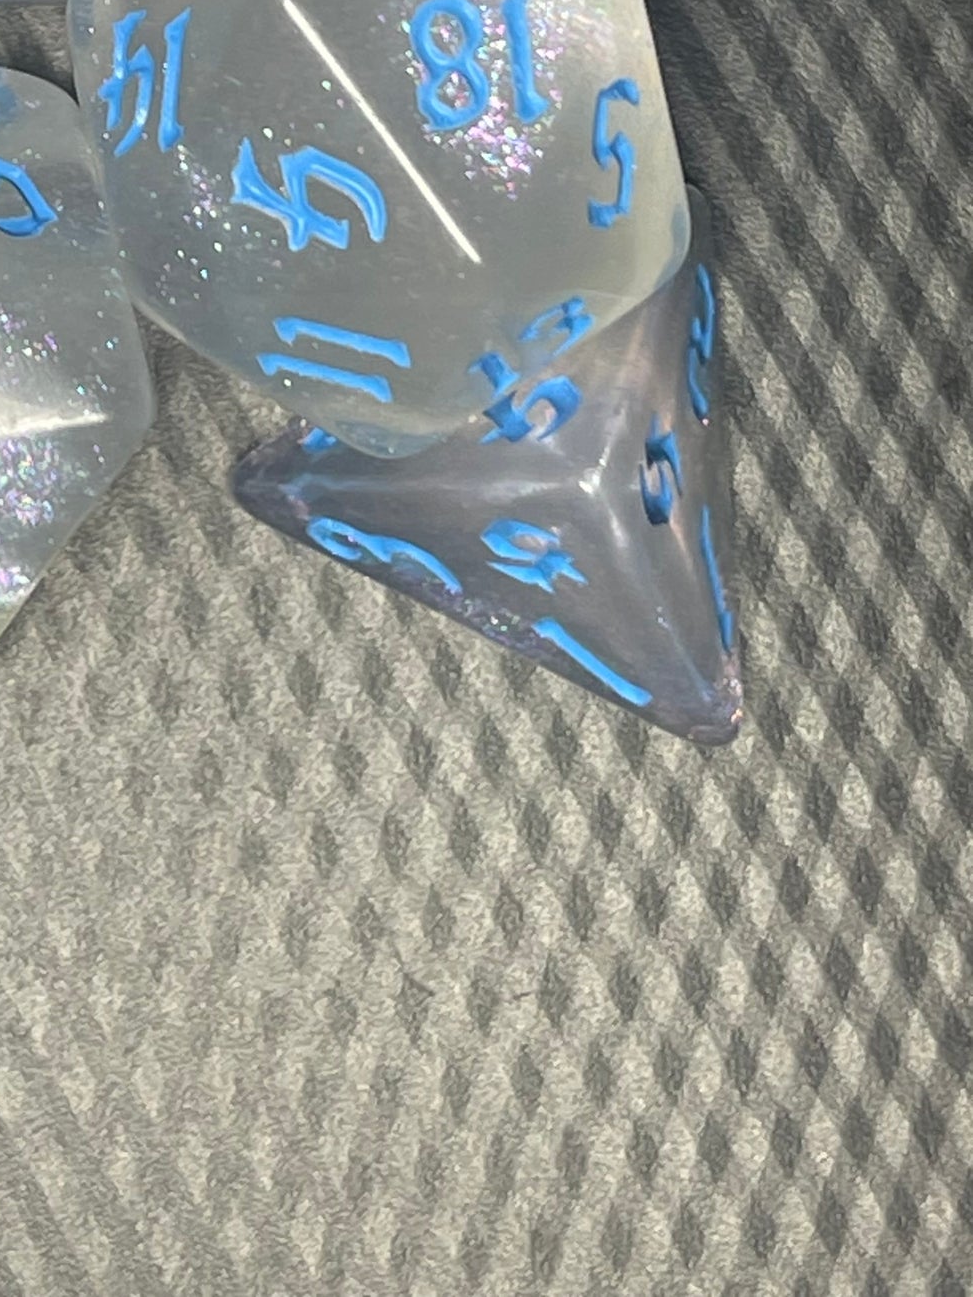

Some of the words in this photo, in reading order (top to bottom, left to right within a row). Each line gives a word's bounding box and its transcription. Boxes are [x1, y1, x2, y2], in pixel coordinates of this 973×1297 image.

[96, 7, 193, 158] 14
[231, 136, 389, 252] 4
[587, 76, 641, 231] 5
[256, 314, 413, 404] 11
